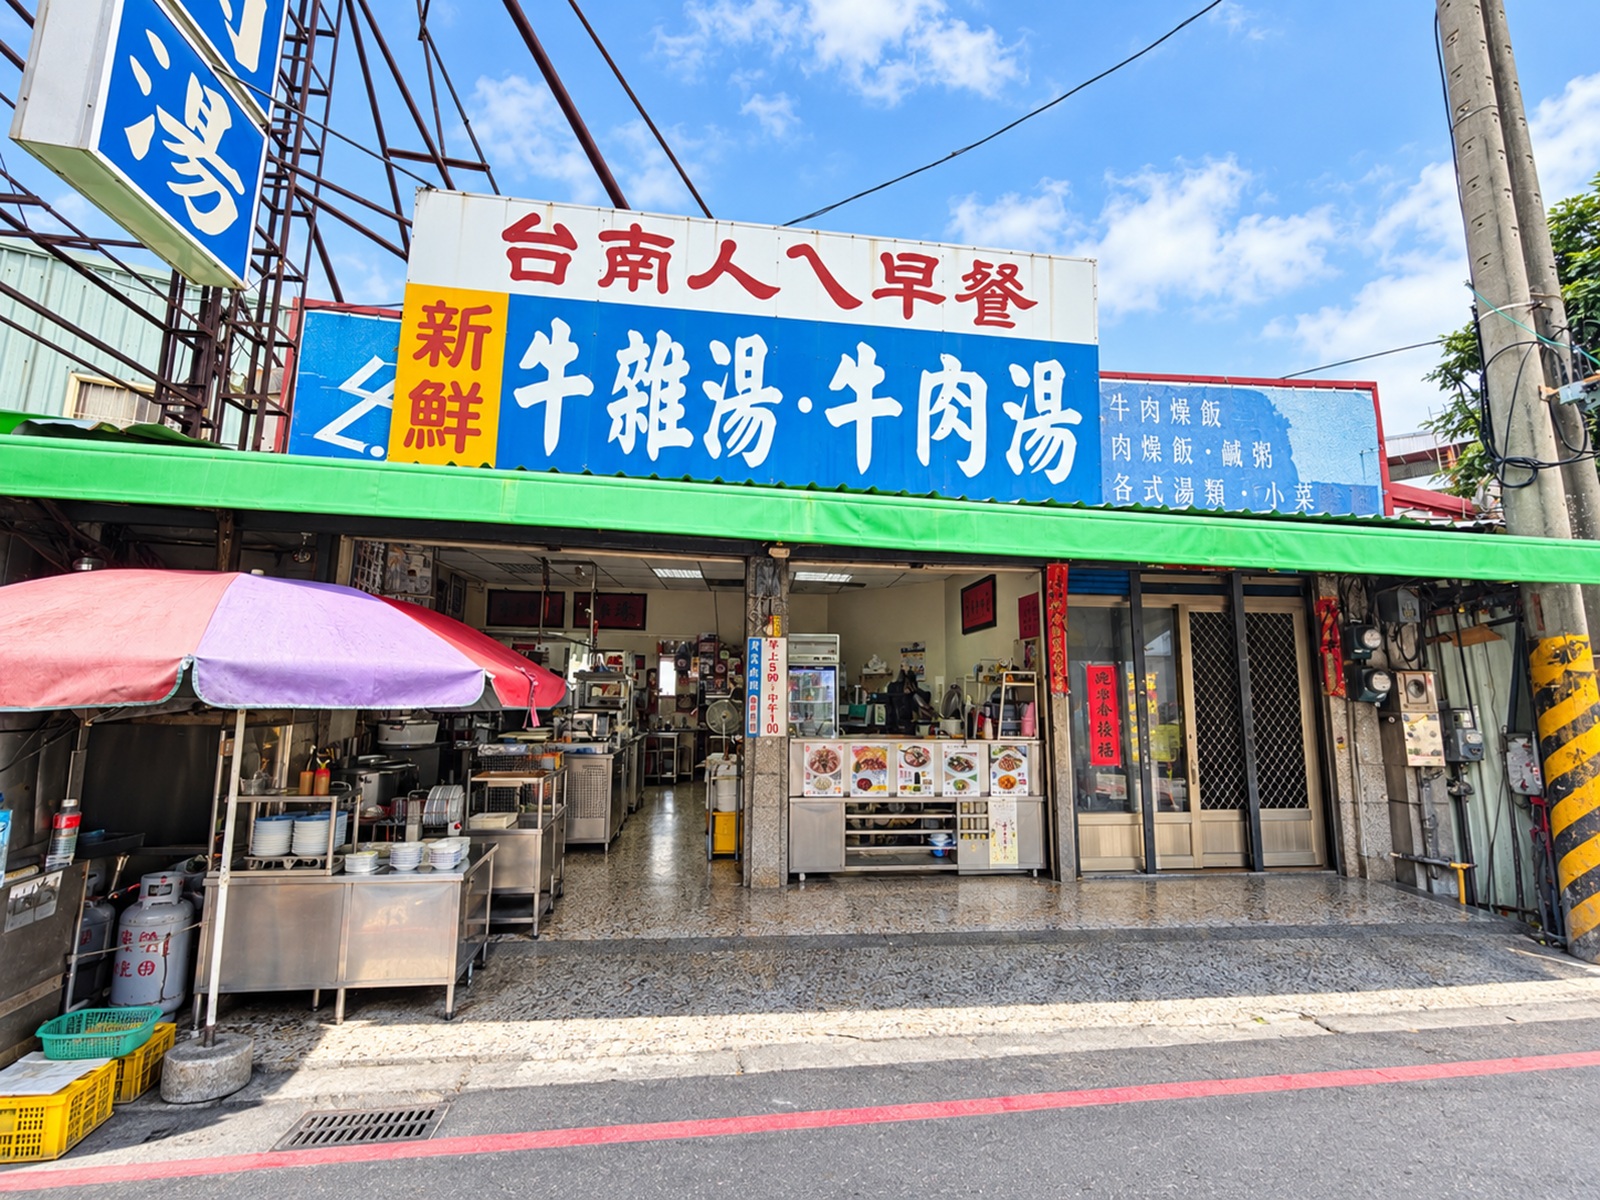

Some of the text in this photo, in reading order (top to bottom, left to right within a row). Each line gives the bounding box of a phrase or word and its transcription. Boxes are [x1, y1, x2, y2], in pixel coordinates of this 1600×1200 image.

[404, 300, 493, 454] 新鮮
[1109, 393, 1222, 428] 牛肉燥飯
